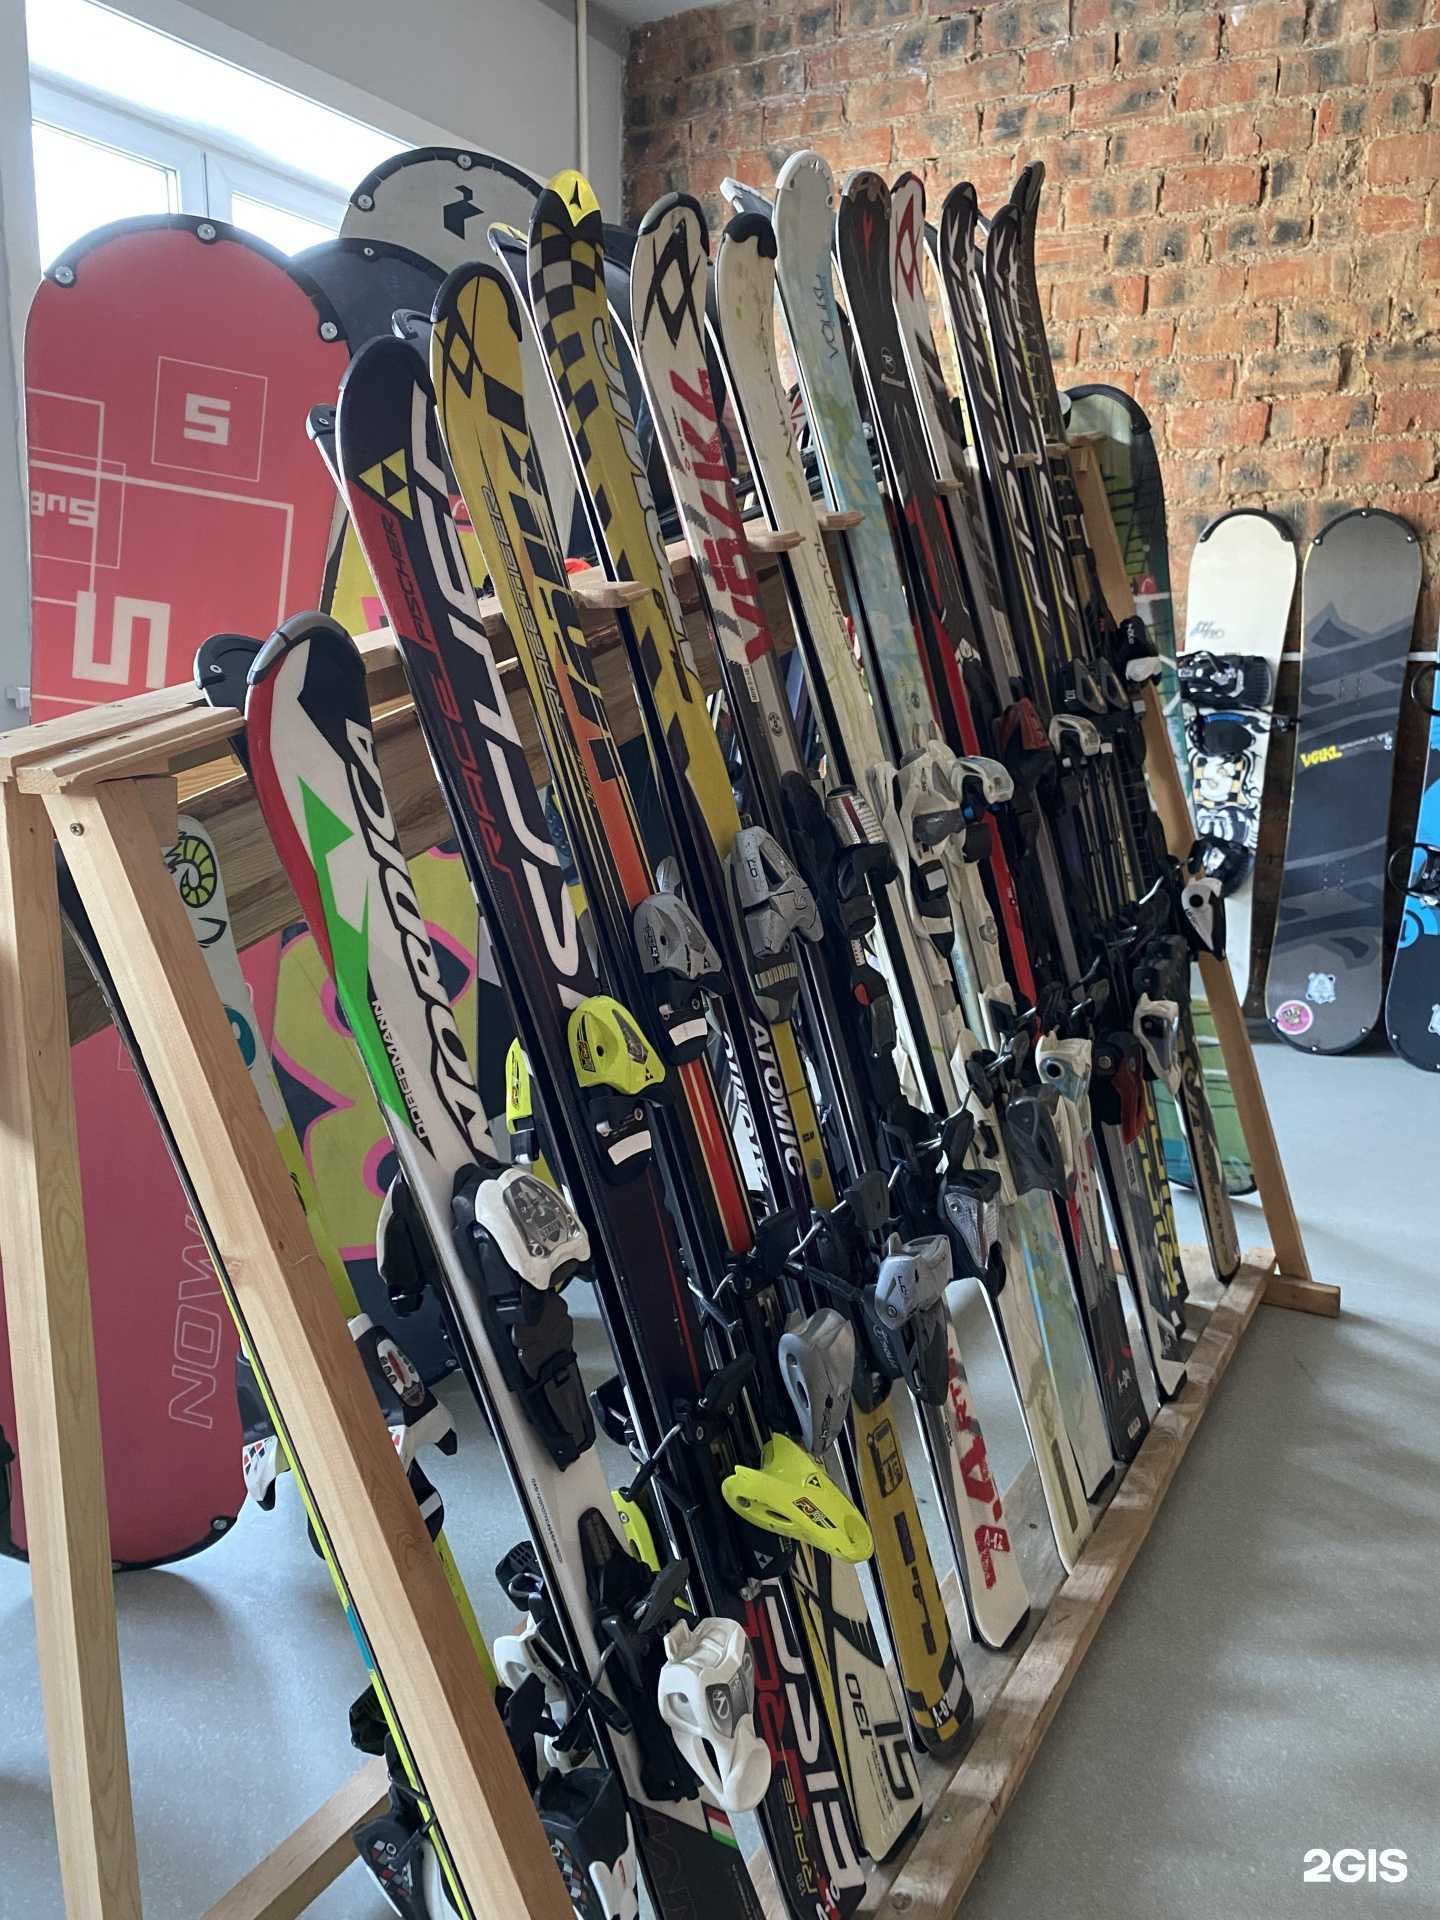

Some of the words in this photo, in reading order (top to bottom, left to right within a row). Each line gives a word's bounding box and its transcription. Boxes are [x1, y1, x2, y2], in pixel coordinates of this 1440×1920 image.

[379, 513, 433, 645] FISCHER
[480, 485, 567, 716] RACETIGER
[345, 717, 498, 1159] NORDICA
[371, 999, 427, 1141] DOBERMANN
[748, 1018, 804, 1176] ATOMIC
[762, 1578, 867, 1890] FISC
[844, 1672, 873, 1742] 130
[780, 1777, 820, 1895] RACE
